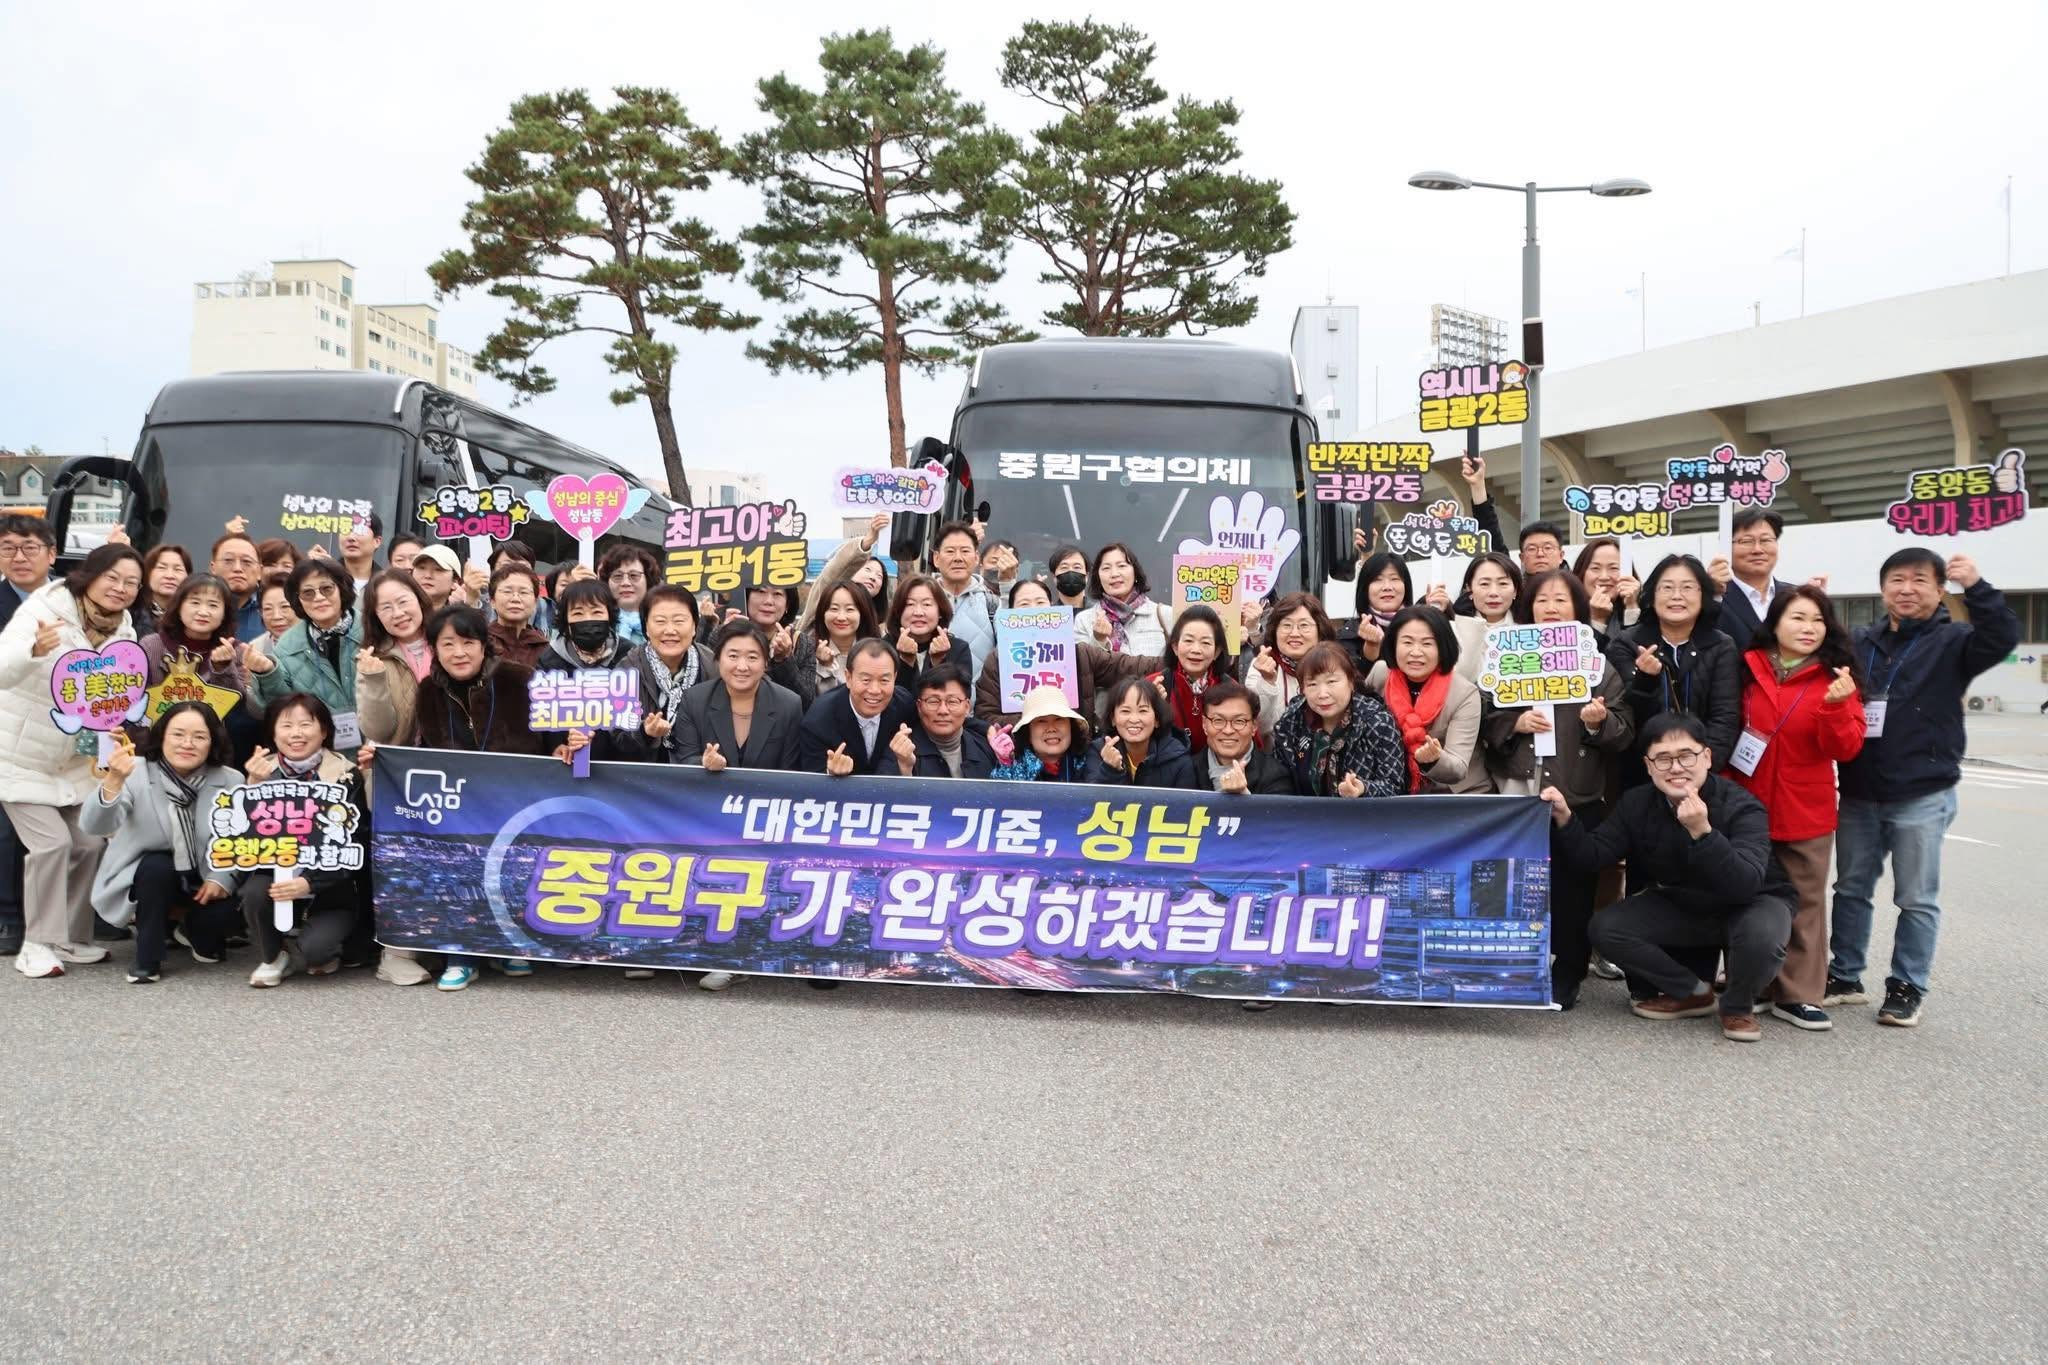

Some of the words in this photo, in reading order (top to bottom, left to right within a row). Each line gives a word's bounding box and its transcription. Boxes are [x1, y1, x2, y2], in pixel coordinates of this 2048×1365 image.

[1420, 365, 1500, 398] 역시나
[1421, 390, 1528, 431] 금광2동
[998, 452, 1251, 486] 중원구협의체
[1308, 443, 1432, 472] 반짝반짝
[1669, 461, 1725, 480] 중앙동에
[1729, 459, 1762, 477] 살면
[1315, 474, 1422, 502] 금광2동
[1669, 481, 1725, 506] 덤으로
[1729, 479, 1774, 505] 행복
[1912, 468, 1993, 500] 중앙동
[282, 493, 333, 514] 성남의
[437, 489, 512, 513] 은행2동
[553, 490, 591, 508] 성남의
[594, 490, 619, 508] 중심
[1591, 487, 1661, 512] 중앙동
[280, 511, 354, 536] 상대원1동
[437, 513, 510, 539] 파이팅
[567, 507, 603, 524] 성남동
[664, 503, 773, 549] 최고야
[1585, 511, 1668, 536] 파이팅!
[1890, 501, 1959, 535] 우리가
[1967, 492, 2025, 531] 최고!
[1217, 531, 1266, 550] 언제나
[664, 541, 807, 593] 금광1동
[1177, 564, 1240, 586] 하대원동
[1185, 585, 1233, 604] 파이팅
[1008, 612, 1062, 630] 하대원동
[1496, 624, 1578, 652] 사랑3배
[1010, 641, 1064, 669] 함께
[1499, 649, 1579, 677] 웃음3배
[60, 678, 79, 703] 폼
[161, 685, 207, 702] 은행1동
[528, 669, 637, 700] 성남동이
[1494, 674, 1588, 704] 상대원3
[89, 695, 132, 718] 은행1동
[530, 699, 614, 729] 최고야
[245, 782, 310, 801] 대한민국의
[312, 784, 344, 804] 기준
[250, 798, 320, 836] 성남
[947, 806, 1057, 859] 기준,
[319, 843, 360, 867] 함께
[880, 868, 1386, 958] 완성하겠습니다!
